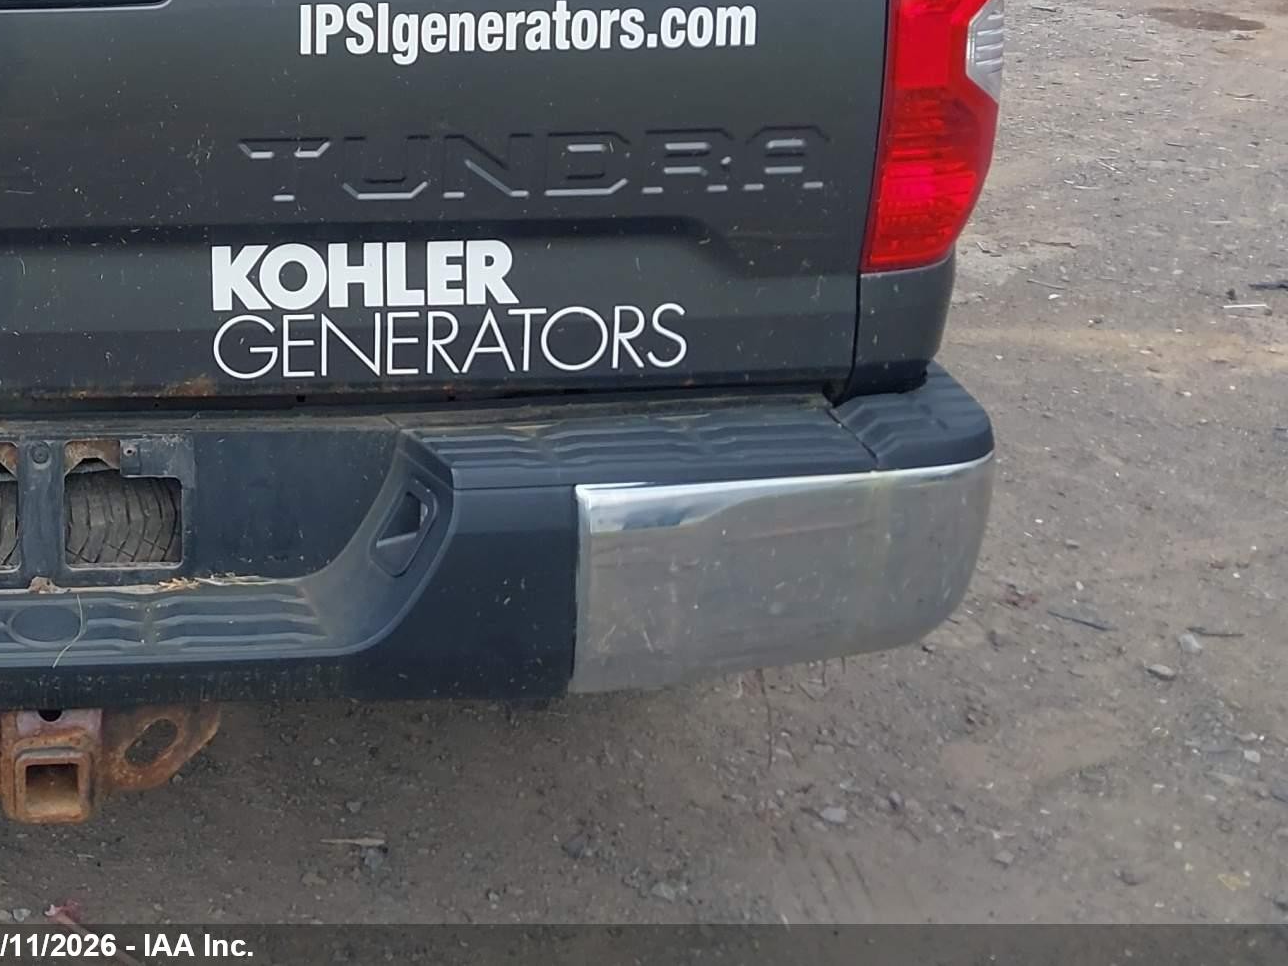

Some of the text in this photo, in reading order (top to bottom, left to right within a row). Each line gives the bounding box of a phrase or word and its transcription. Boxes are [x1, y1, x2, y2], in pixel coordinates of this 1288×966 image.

[299, 0, 756, 64] IPSIgenerators.com
[239, 125, 829, 202] TUNDRA
[212, 239, 519, 311] KOHLER
[213, 303, 687, 379] GENERATORS
